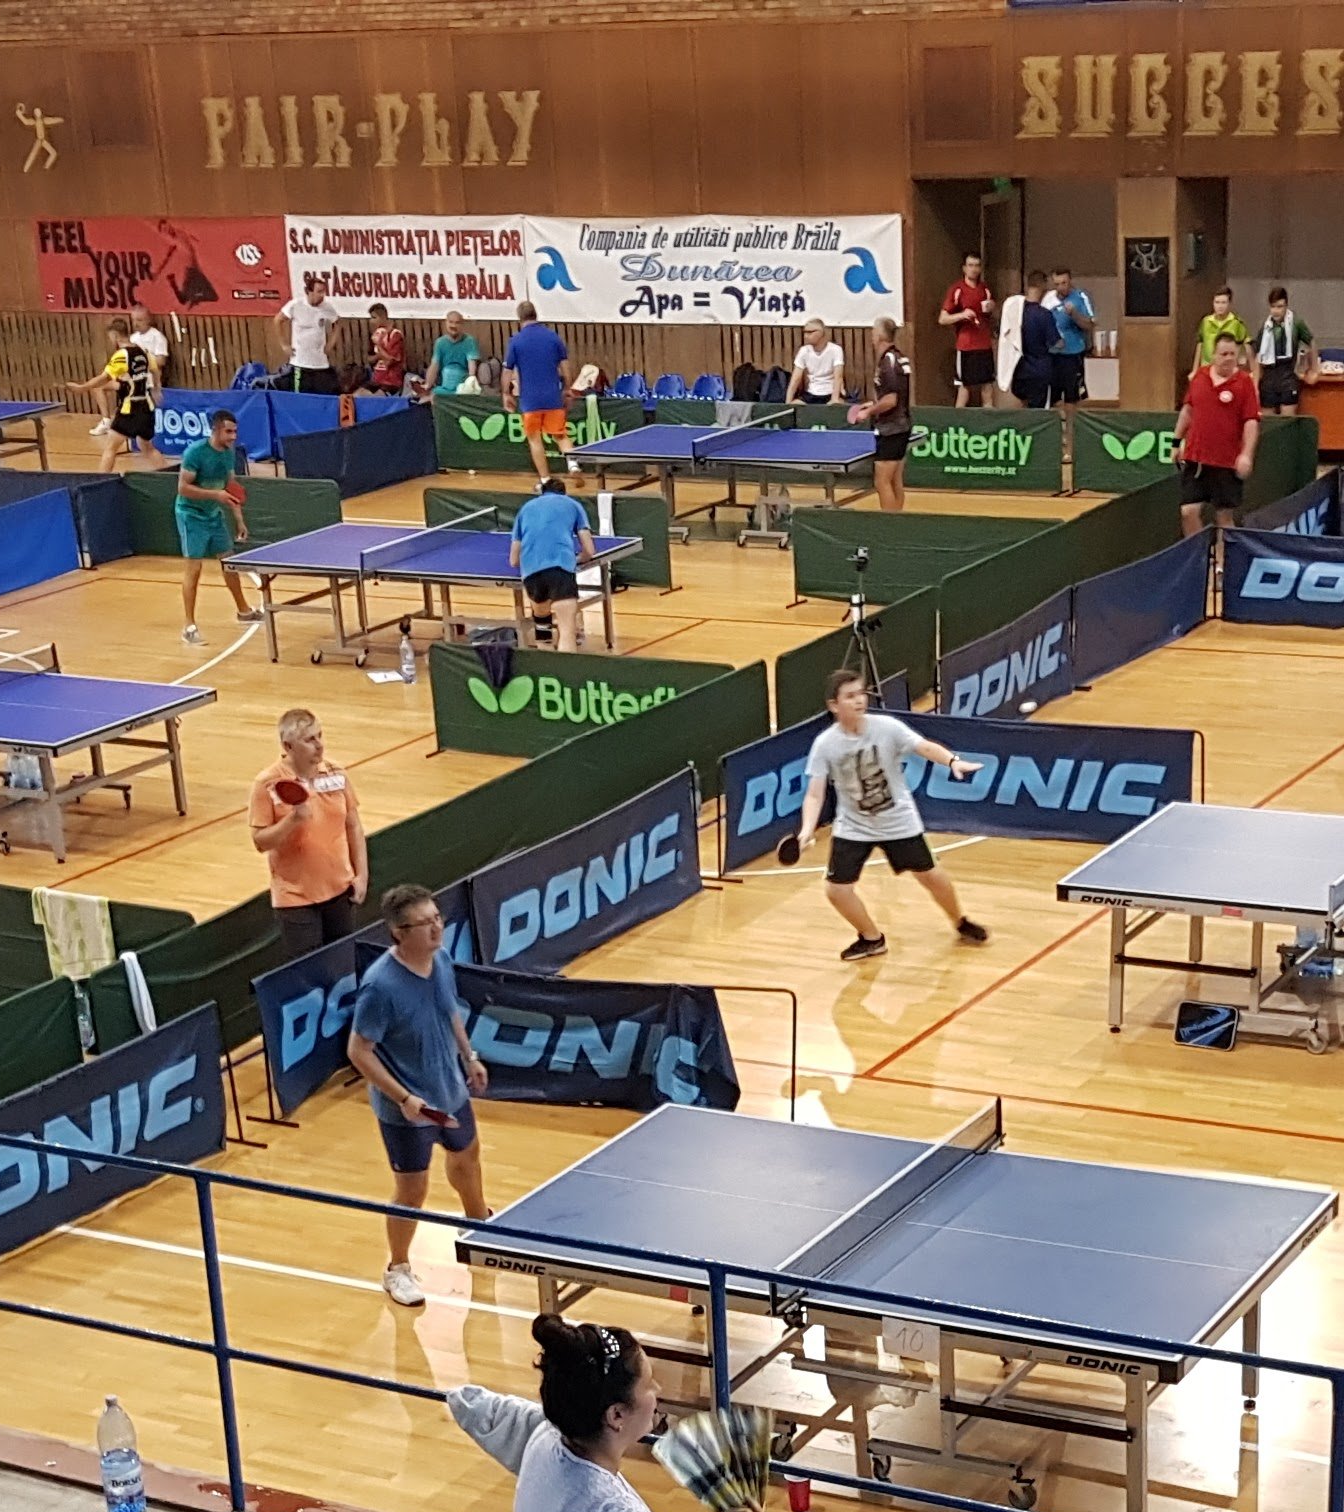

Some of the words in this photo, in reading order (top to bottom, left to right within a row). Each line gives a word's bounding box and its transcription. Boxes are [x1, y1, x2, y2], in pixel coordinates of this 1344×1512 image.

[37, 220, 93, 254] FEEL
[289, 227, 318, 253] S.C.
[579, 224, 646, 256] Compania
[652, 226, 669, 249] de
[733, 224, 788, 252] publice
[88, 250, 154, 281] YOUR
[64, 277, 140, 309] MUSIC
[423, 272, 453, 299] S.A.
[619, 286, 683, 318] Apa
[951, 623, 1064, 718] DONIC
[494, 812, 682, 963] DONIC
[1080, 894, 1133, 907] DONIC
[484, 1257, 547, 1276] DONIC
[896, 1326, 924, 1353] 10
[1065, 1354, 1142, 1377] DONIC
